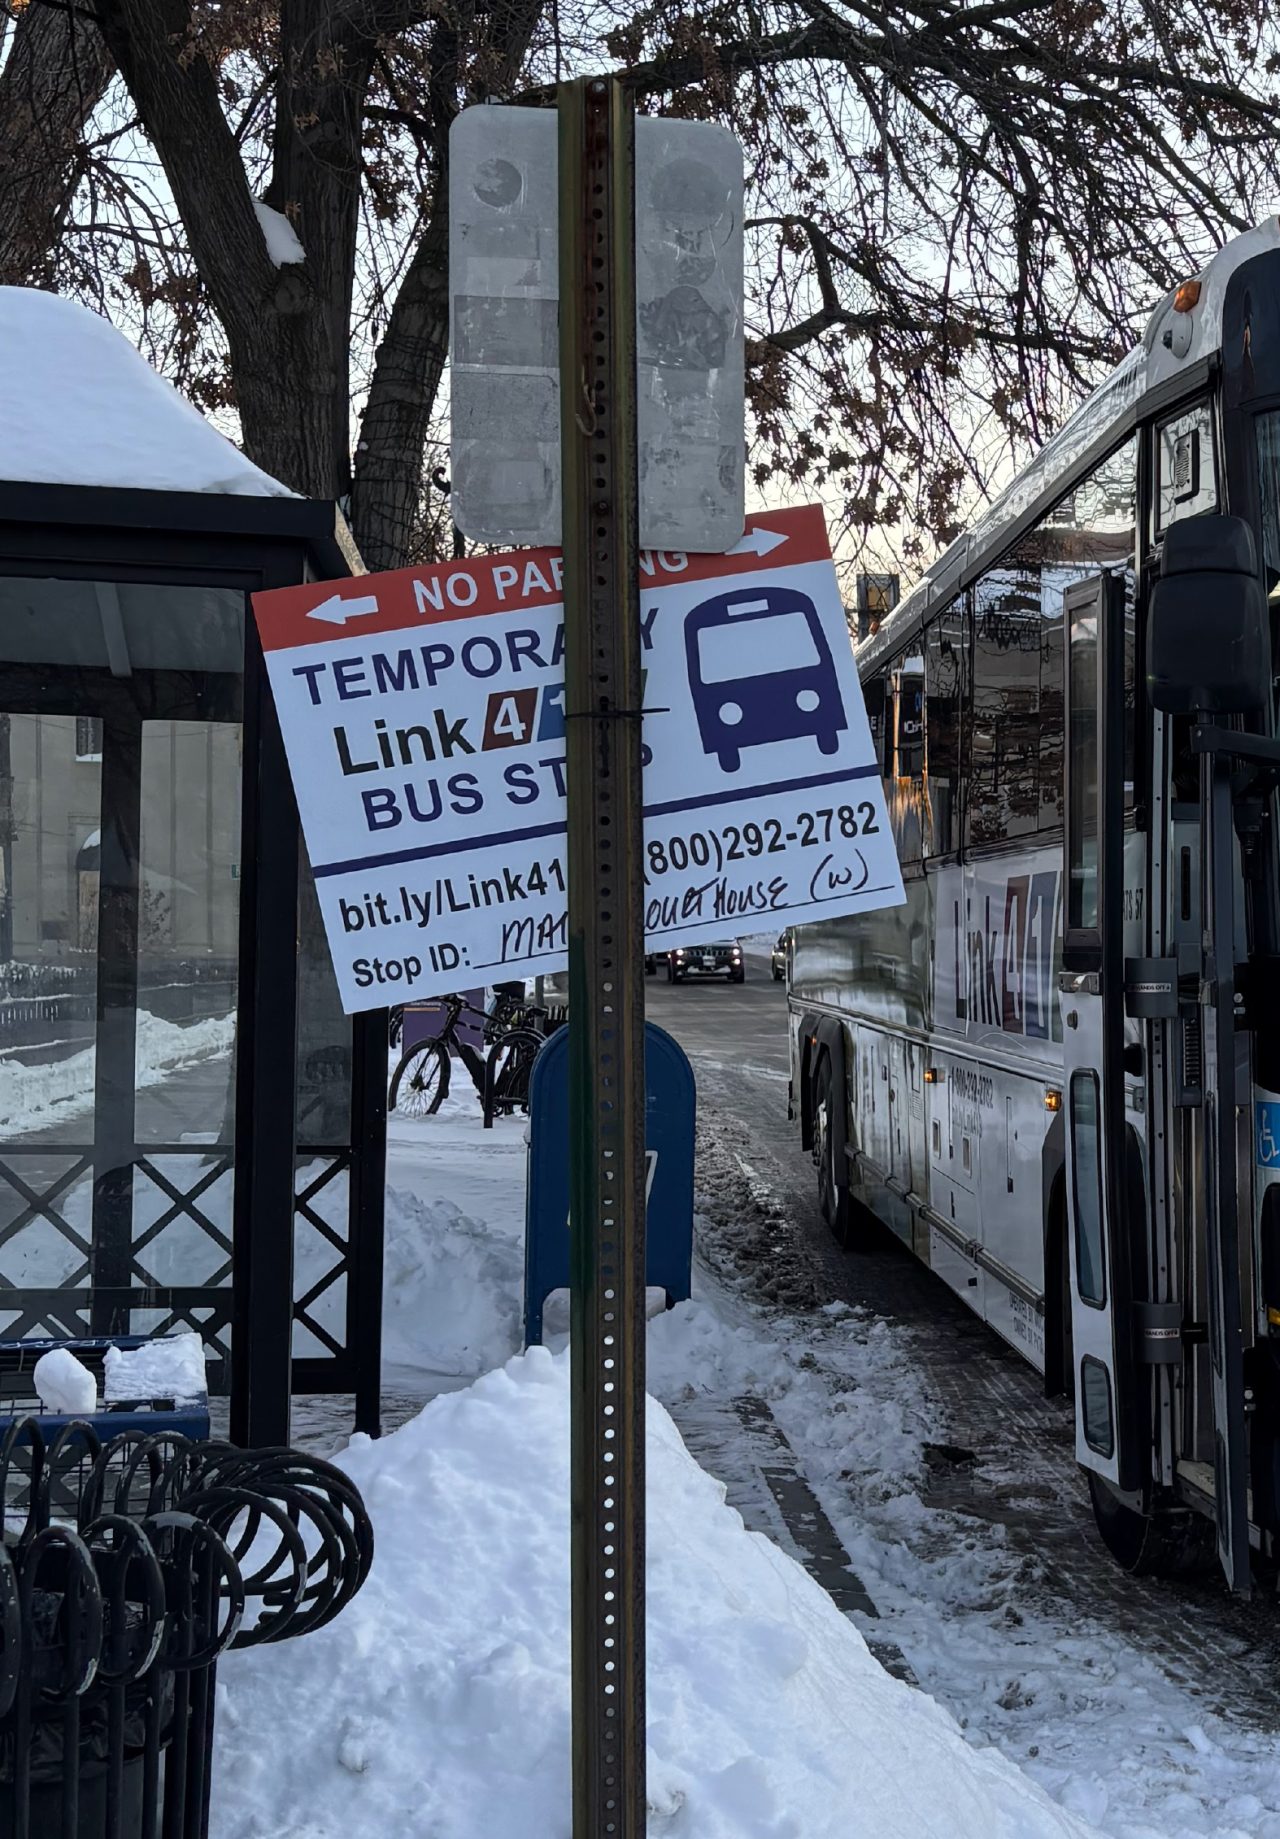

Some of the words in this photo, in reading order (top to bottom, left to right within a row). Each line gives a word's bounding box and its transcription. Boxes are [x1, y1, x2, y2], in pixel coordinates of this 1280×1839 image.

[413, 572, 478, 613] NO
[492, 550, 689, 601] PANG
[292, 607, 659, 705] TEMPORY
[333, 685, 566, 776] Link4
[361, 773, 484, 832] BUS
[339, 858, 566, 933] bit.ly/Link41
[643, 801, 880, 885] 800)292-2782
[352, 957, 422, 988] Stop
[429, 943, 471, 973] ID:
[955, 895, 1063, 1029] Link41
